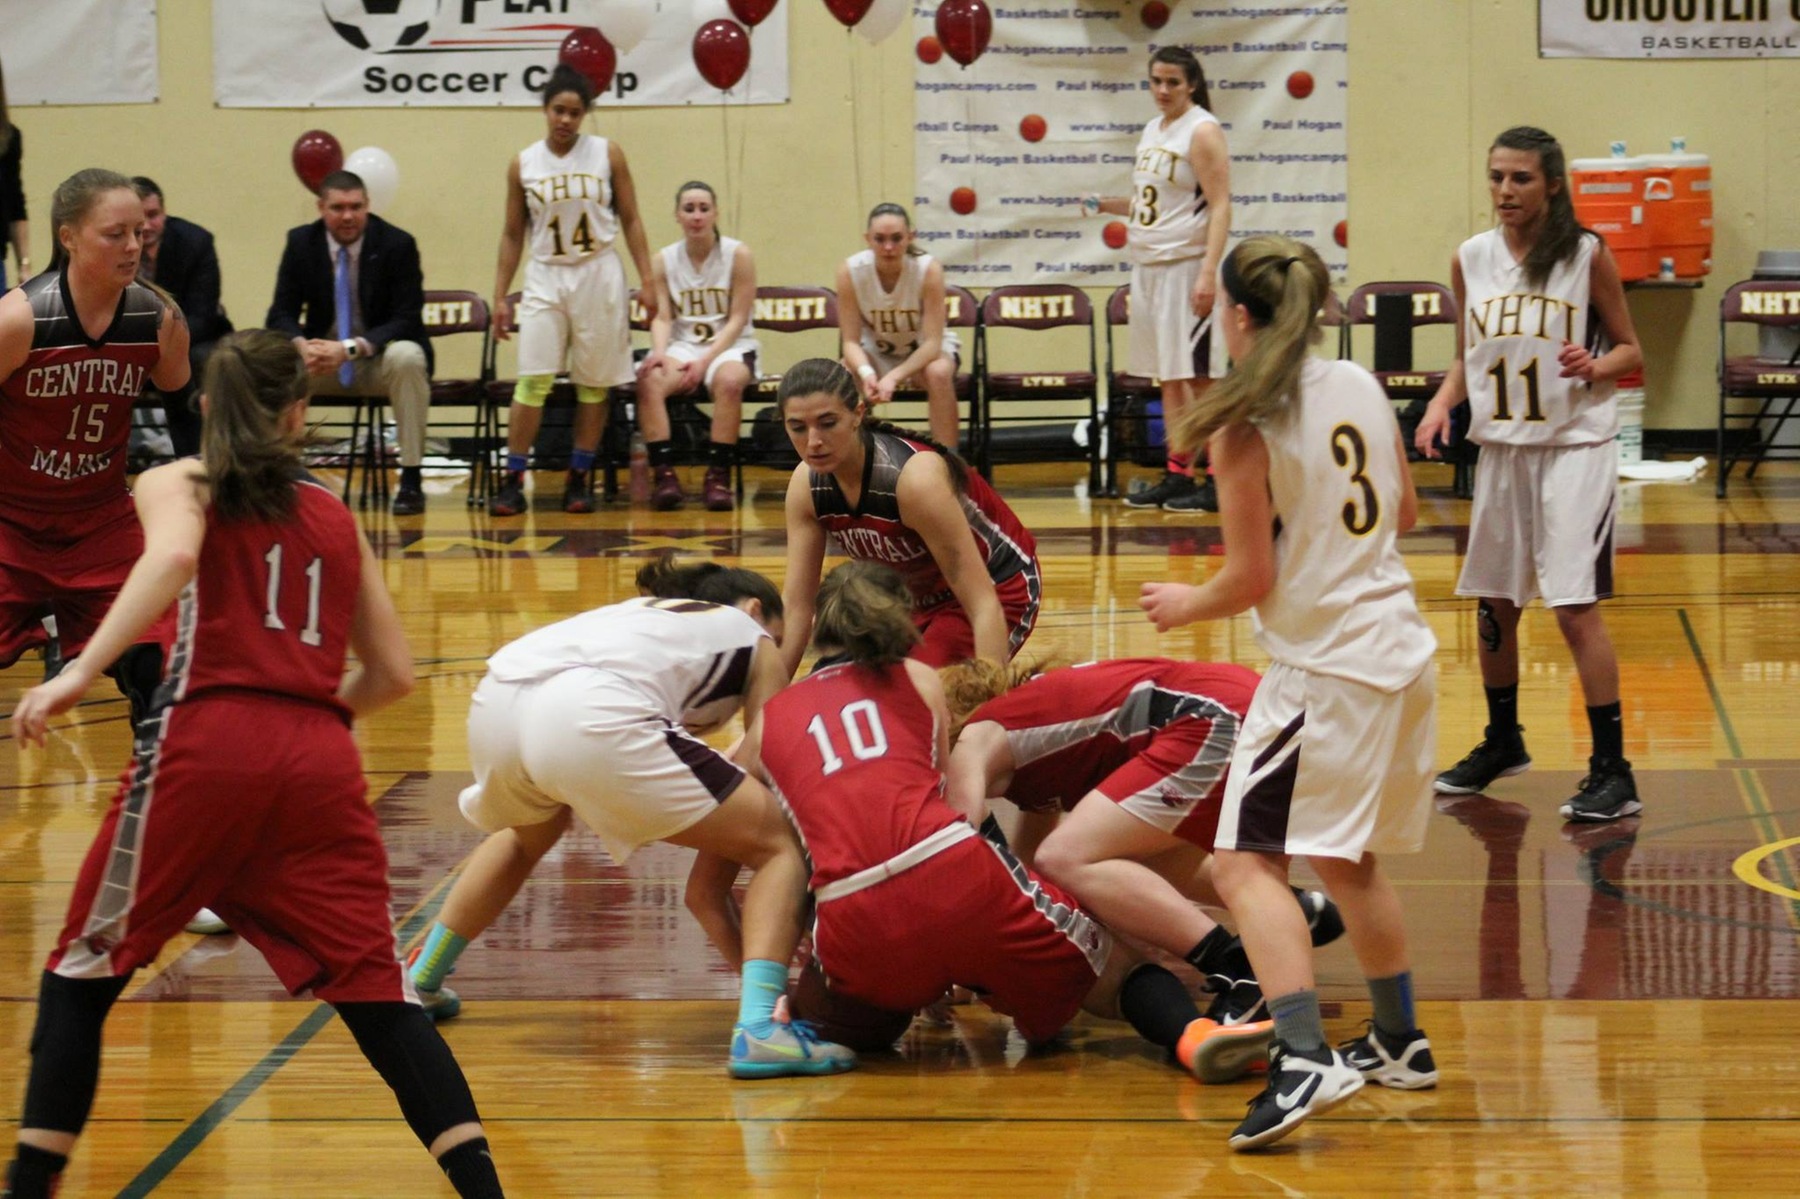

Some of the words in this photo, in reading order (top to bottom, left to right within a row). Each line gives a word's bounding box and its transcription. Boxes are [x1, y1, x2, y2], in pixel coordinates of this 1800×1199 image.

[995, 9, 1069, 19] Basketball
[1074, 8, 1120, 20] Camps
[1233, 42, 1306, 53] Basketball
[1642, 36, 1797, 49] BASKETBALL
[363, 66, 508, 93] Soccer
[522, 65, 638, 98] Cp
[1056, 81, 1086, 91] Paul
[1091, 80, 1136, 93] Hogan
[1218, 79, 1266, 91] Camps
[953, 121, 999, 133] Camps
[1263, 120, 1293, 130] Paul
[1298, 119, 1342, 131] Hogan
[941, 154, 970, 164] Paul
[975, 154, 1018, 167] Hogan
[1023, 153, 1097, 164] Basketball
[1272, 192, 1346, 203] Basketball
[547, 211, 596, 256] 14
[1034, 228, 1081, 241] Camps
[1036, 262, 1065, 272] Paul
[1070, 261, 1115, 274] Hogan
[421, 301, 472, 326] HTI
[754, 297, 826, 321] NHTI
[1000, 295, 1075, 319] NHTI
[1741, 291, 1800, 315] NHT
[1469, 293, 1578, 349] NHTI
[25, 358, 145, 398] CENTRAL
[1487, 356, 1547, 422] 11
[66, 403, 109, 443] 15
[1331, 421, 1381, 537] 3
[264, 543, 322, 647] 11
[807, 699, 888, 776] 10
